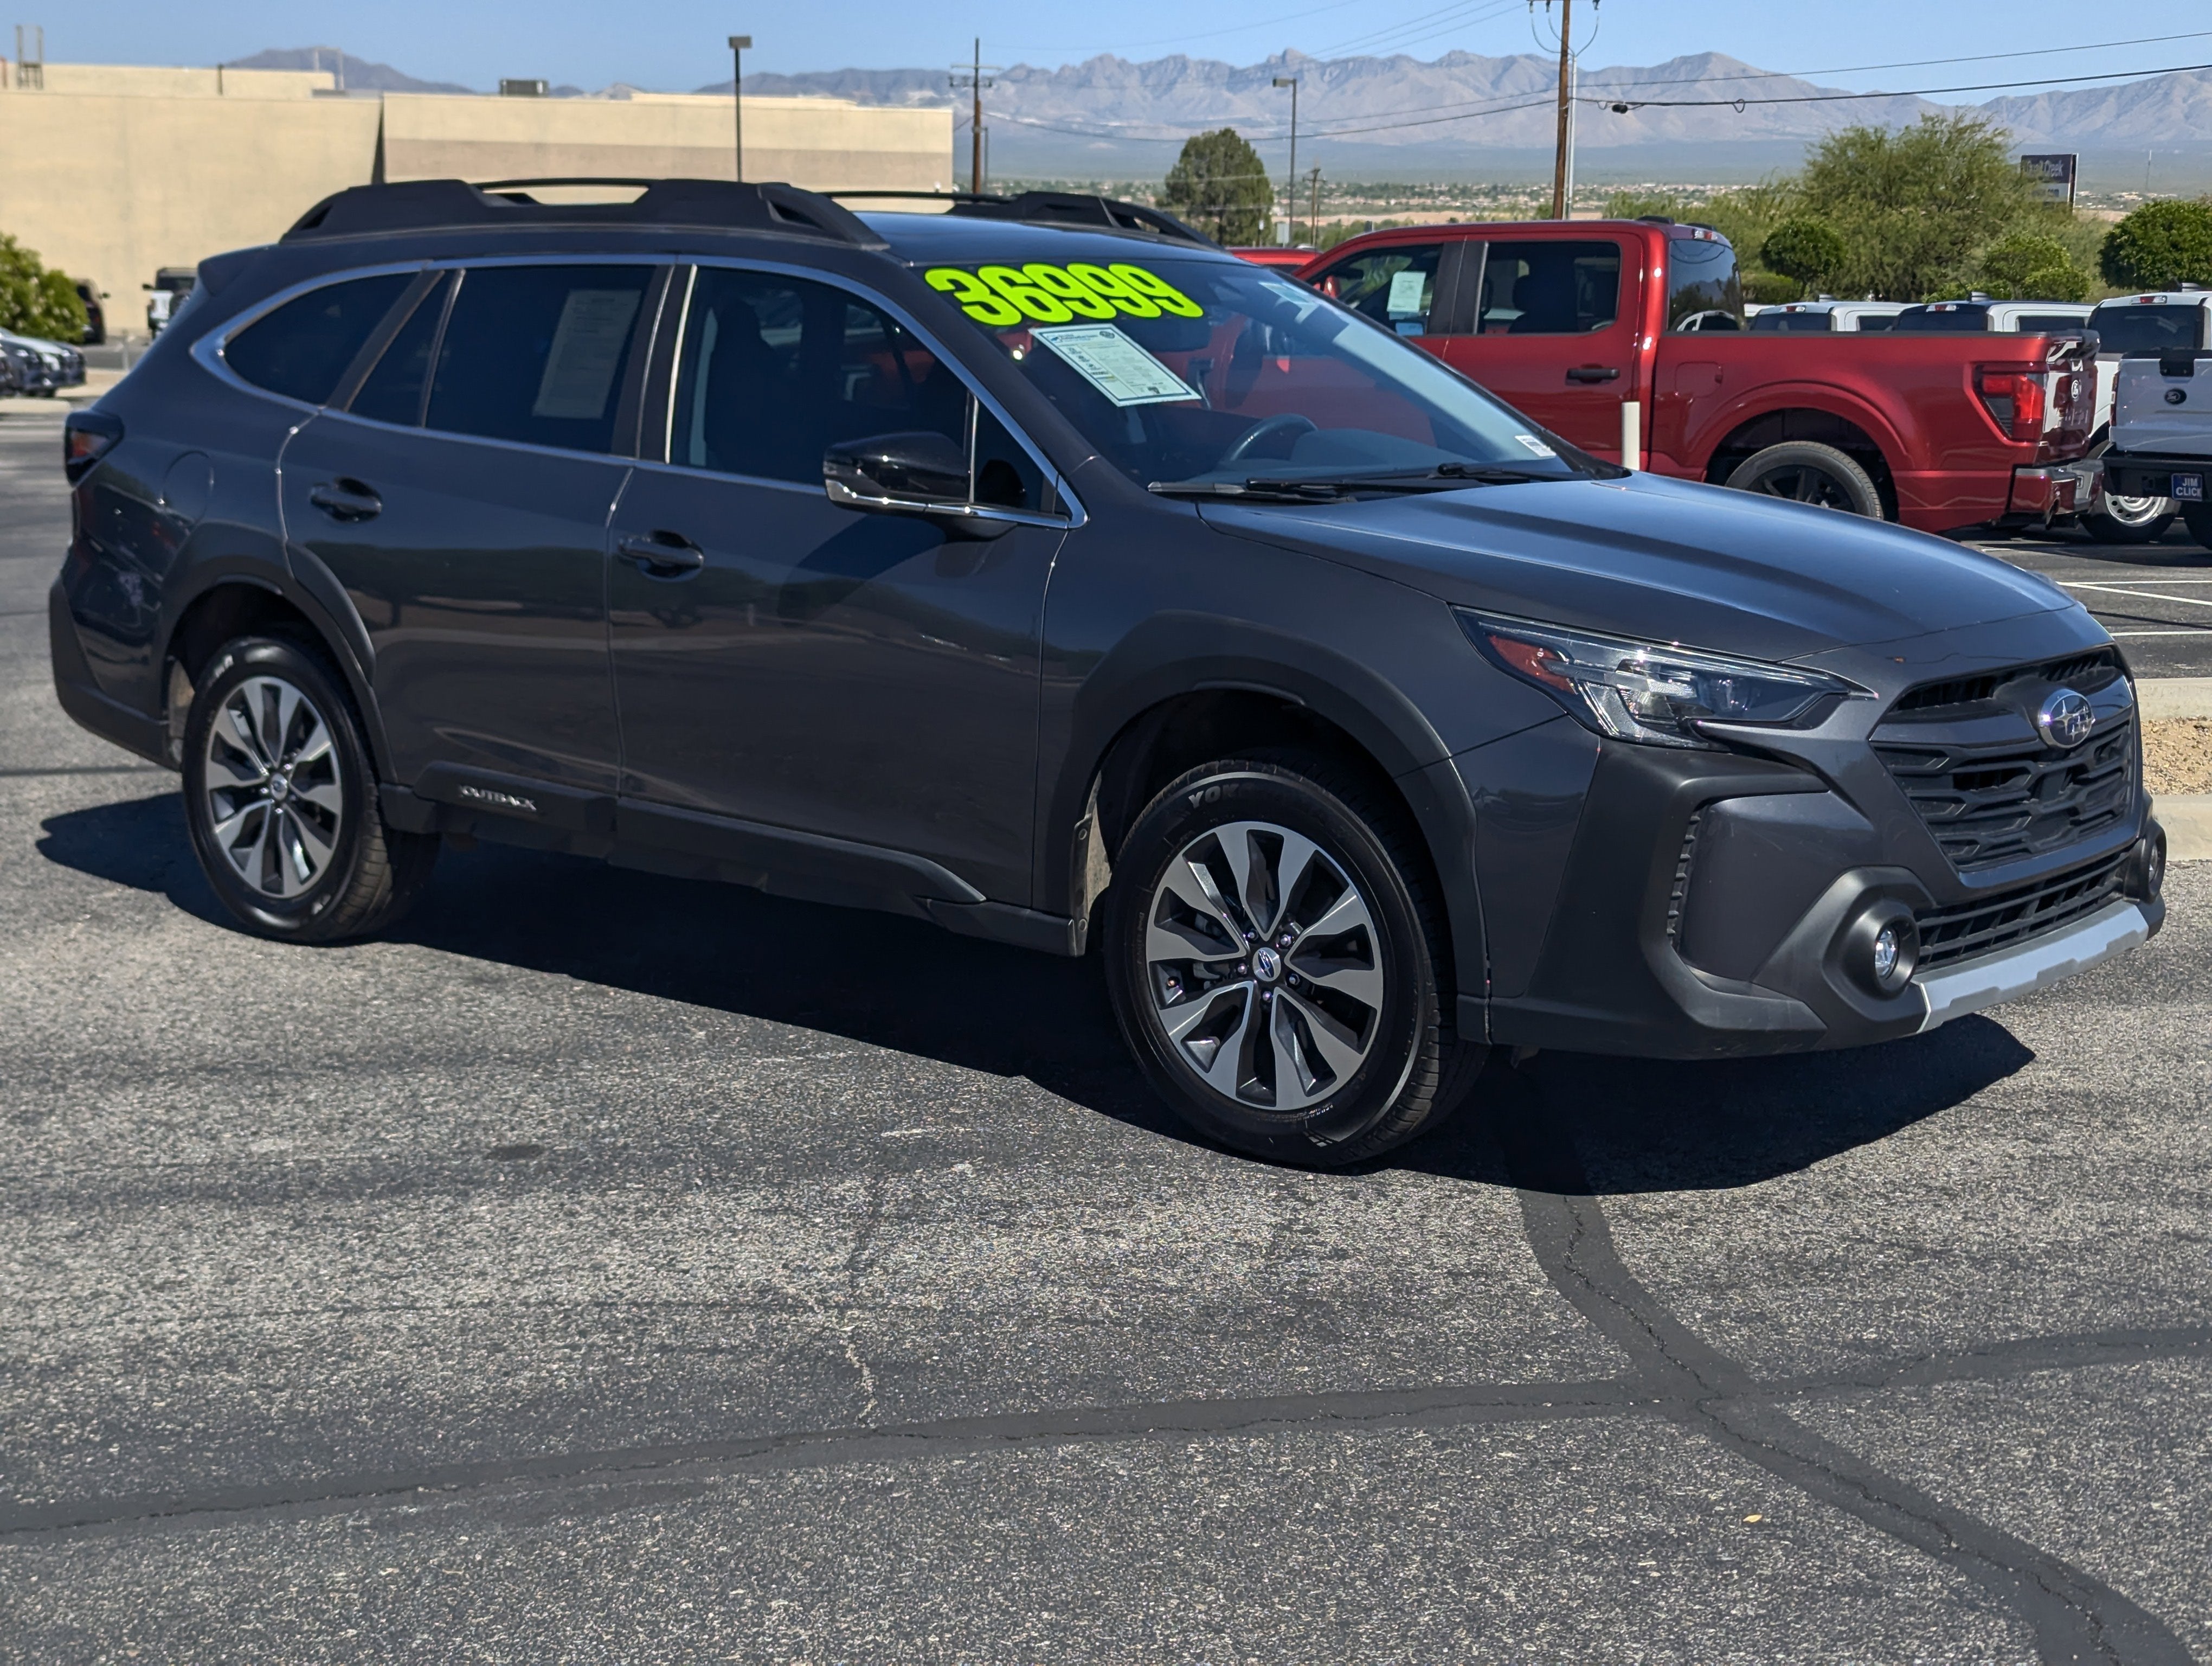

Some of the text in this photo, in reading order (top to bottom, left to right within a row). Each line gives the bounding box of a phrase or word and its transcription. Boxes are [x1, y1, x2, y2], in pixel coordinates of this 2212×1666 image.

[925, 263, 1204, 325] 36999
[2182, 478, 2198, 486] JIM
[2176, 487, 2202, 497] CLICK
[459, 785, 537, 810] OUTBACK
